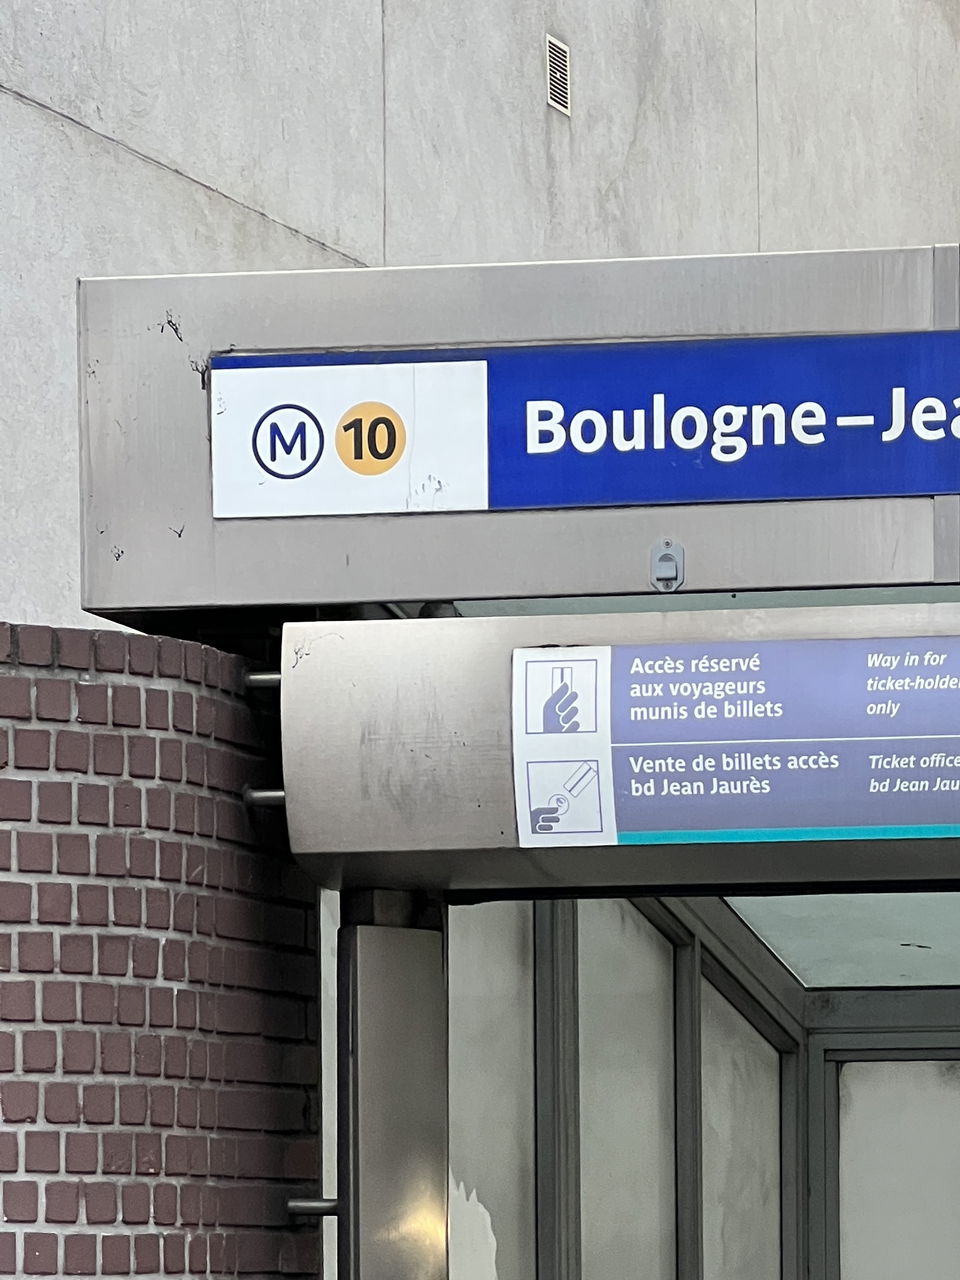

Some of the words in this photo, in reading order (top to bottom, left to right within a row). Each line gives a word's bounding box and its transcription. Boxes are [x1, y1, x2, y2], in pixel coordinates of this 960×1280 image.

[269, 424, 308, 462] M
[343, 417, 396, 459] 10
[629, 656, 685, 675] Accès
[690, 653, 761, 673] réservé
[867, 652, 900, 670] Way
[903, 652, 920, 667] in
[921, 650, 947, 668] for
[629, 681, 664, 697] aux
[668, 678, 766, 701] voyageurs
[629, 703, 689, 721] munis
[693, 701, 718, 719] de
[723, 698, 783, 719] billets
[866, 700, 901, 718] only
[629, 755, 686, 774] Vente
[691, 753, 716, 772] de
[721, 752, 782, 772] billets
[787, 750, 840, 770] accès
[869, 753, 915, 770] Ticket
[630, 777, 657, 797] bd
[660, 777, 705, 798] Jean
[709, 774, 771, 795] Jaurès
[869, 776, 892, 794] bd
[893, 776, 932, 794] Jean
